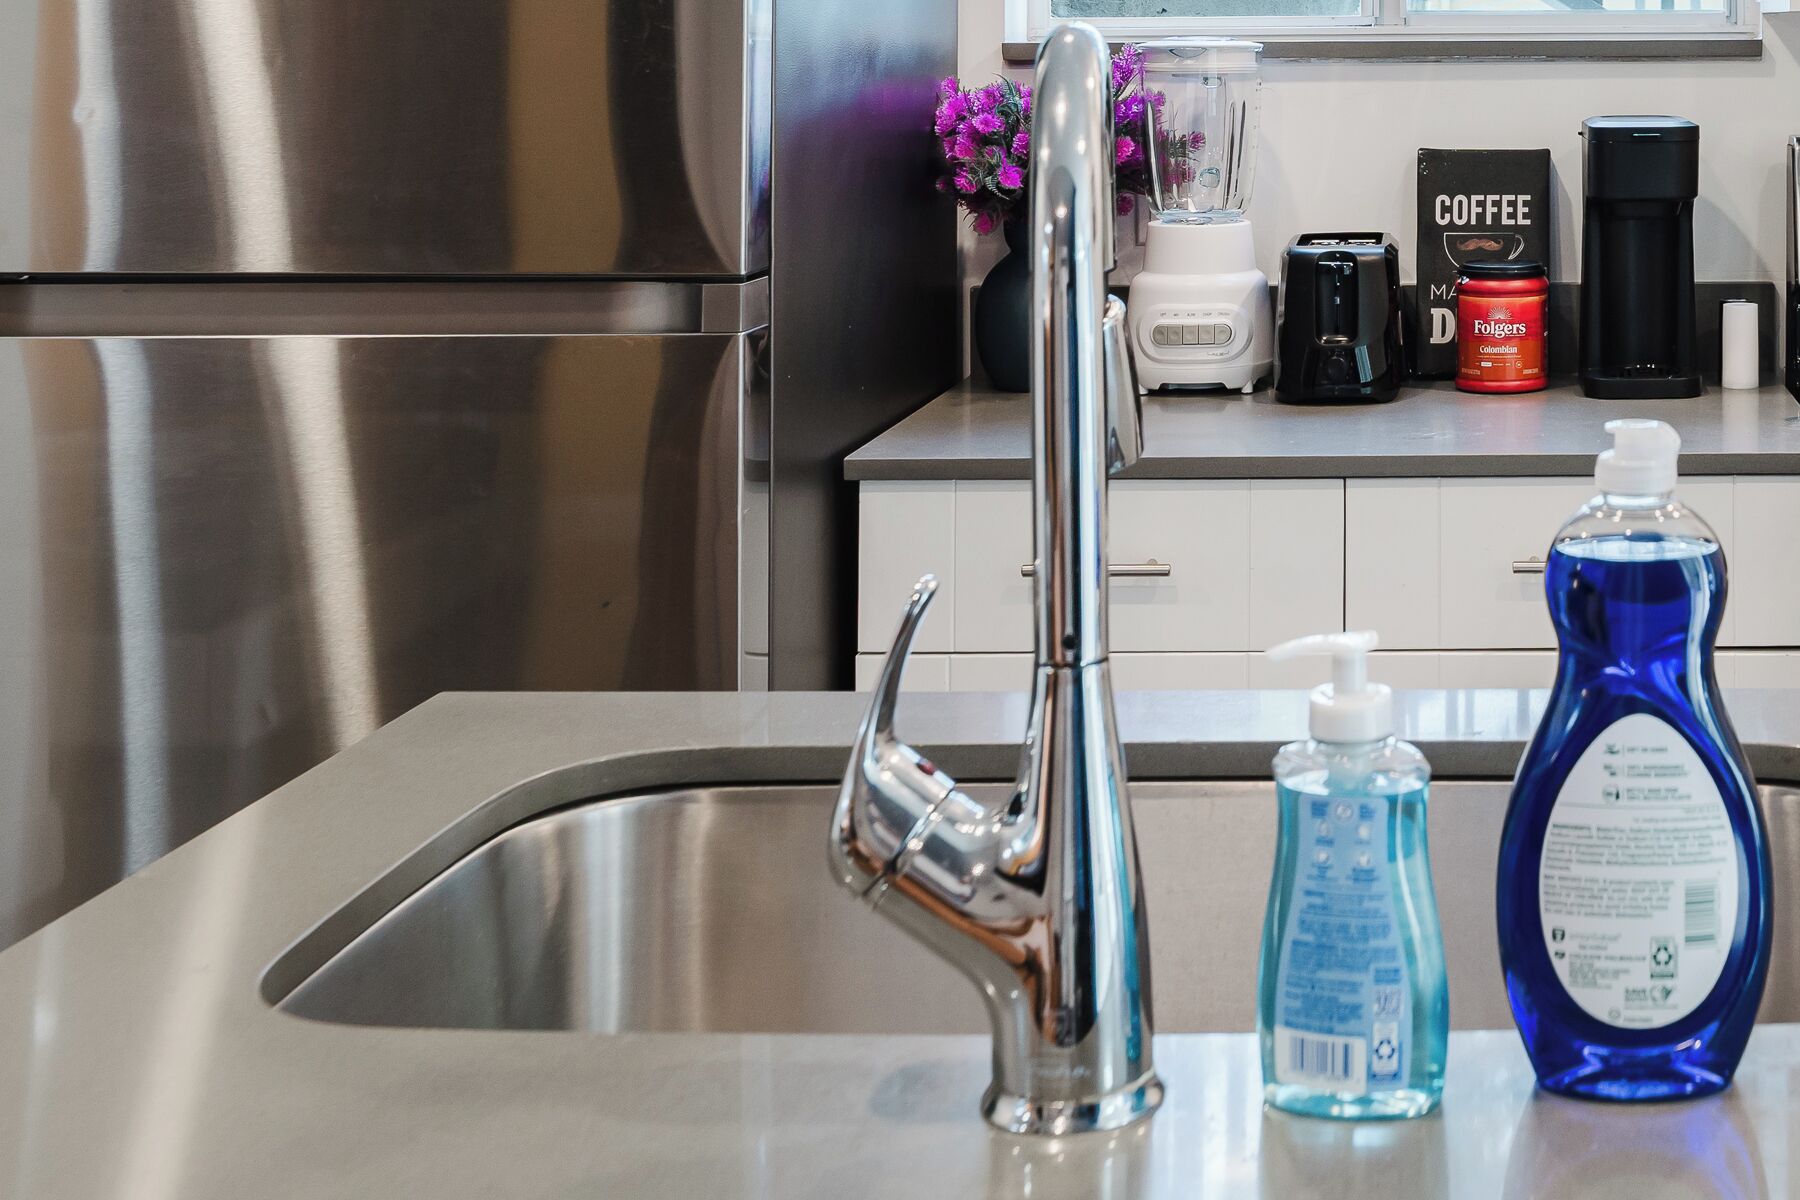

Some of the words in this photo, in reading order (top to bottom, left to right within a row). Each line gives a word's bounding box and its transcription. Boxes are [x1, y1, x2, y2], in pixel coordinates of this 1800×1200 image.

[1434, 194, 1532, 226] COFFEE
[1474, 319, 1526, 339] Folgers
[1479, 345, 1518, 354] Colombian
